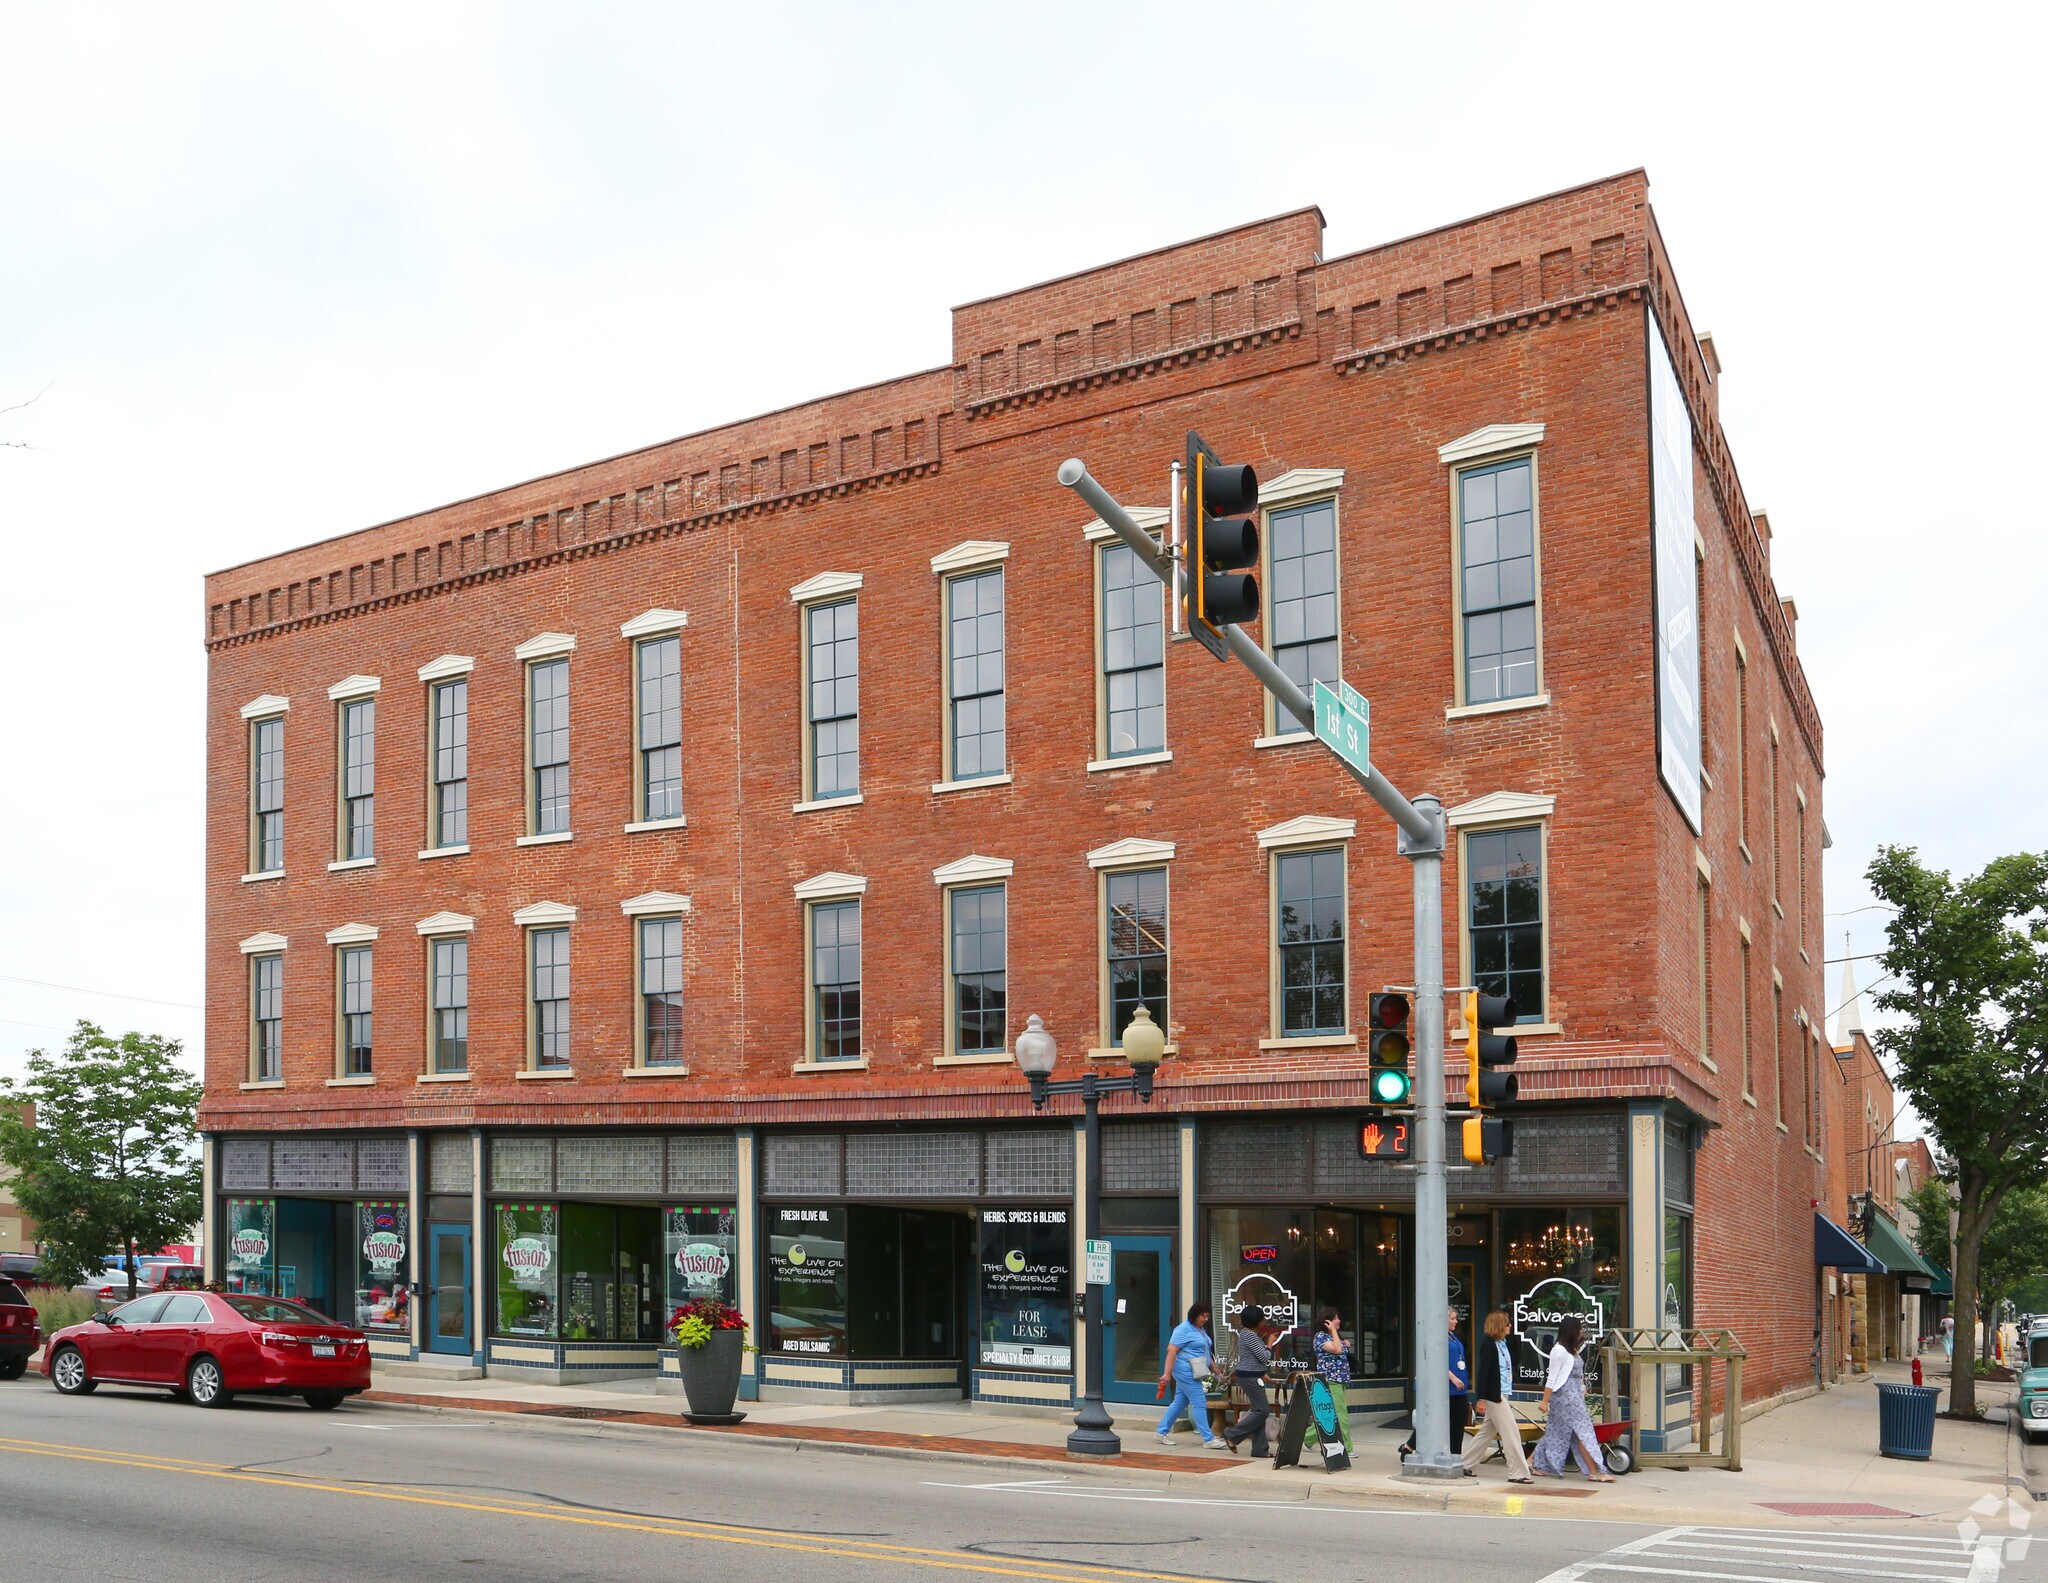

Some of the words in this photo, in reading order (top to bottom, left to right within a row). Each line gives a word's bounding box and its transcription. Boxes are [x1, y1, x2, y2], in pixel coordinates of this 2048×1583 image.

[1344, 688, 1358, 709] 300
[1360, 702, 1366, 716] E
[1326, 704, 1340, 739] 1st
[1346, 723, 1359, 755] St
[1394, 1124, 1406, 1152] 2
[780, 1210, 800, 1221] FRESH
[801, 1210, 818, 1221] OLIVE
[819, 1210, 829, 1221] OIL
[983, 1211, 1008, 1224] HERBS,
[1008, 1211, 1032, 1222] SPICES
[1033, 1212, 1038, 1222] &
[1040, 1212, 1066, 1223] BLENDS
[234, 1233, 265, 1255] fusion
[366, 1236, 401, 1260] fusion
[1088, 1241, 1092, 1252] 1
[1096, 1244, 1107, 1252] HR
[506, 1243, 546, 1268] fusion
[1242, 1248, 1277, 1259] OPEN
[678, 1248, 724, 1276] fusion
[770, 1256, 788, 1266] THE
[778, 1266, 836, 1276] EXPERIENCE
[982, 1264, 1003, 1272] THE
[1050, 1266, 1068, 1274] OIL
[991, 1273, 1058, 1283] EXPERIENCE
[1225, 1298, 1293, 1319] Salged
[1019, 1310, 1040, 1323] FOR
[1012, 1324, 1047, 1338] LEASE
[783, 1340, 798, 1351] AGED
[800, 1341, 830, 1353] BALSAMIC
[983, 1351, 1018, 1364] SPECIALTY
[1019, 1353, 1051, 1365] GOURMET
[1052, 1355, 1070, 1367] SHOP
[1291, 1357, 1308, 1370] Shop
[1520, 1366, 1544, 1378] Estate
